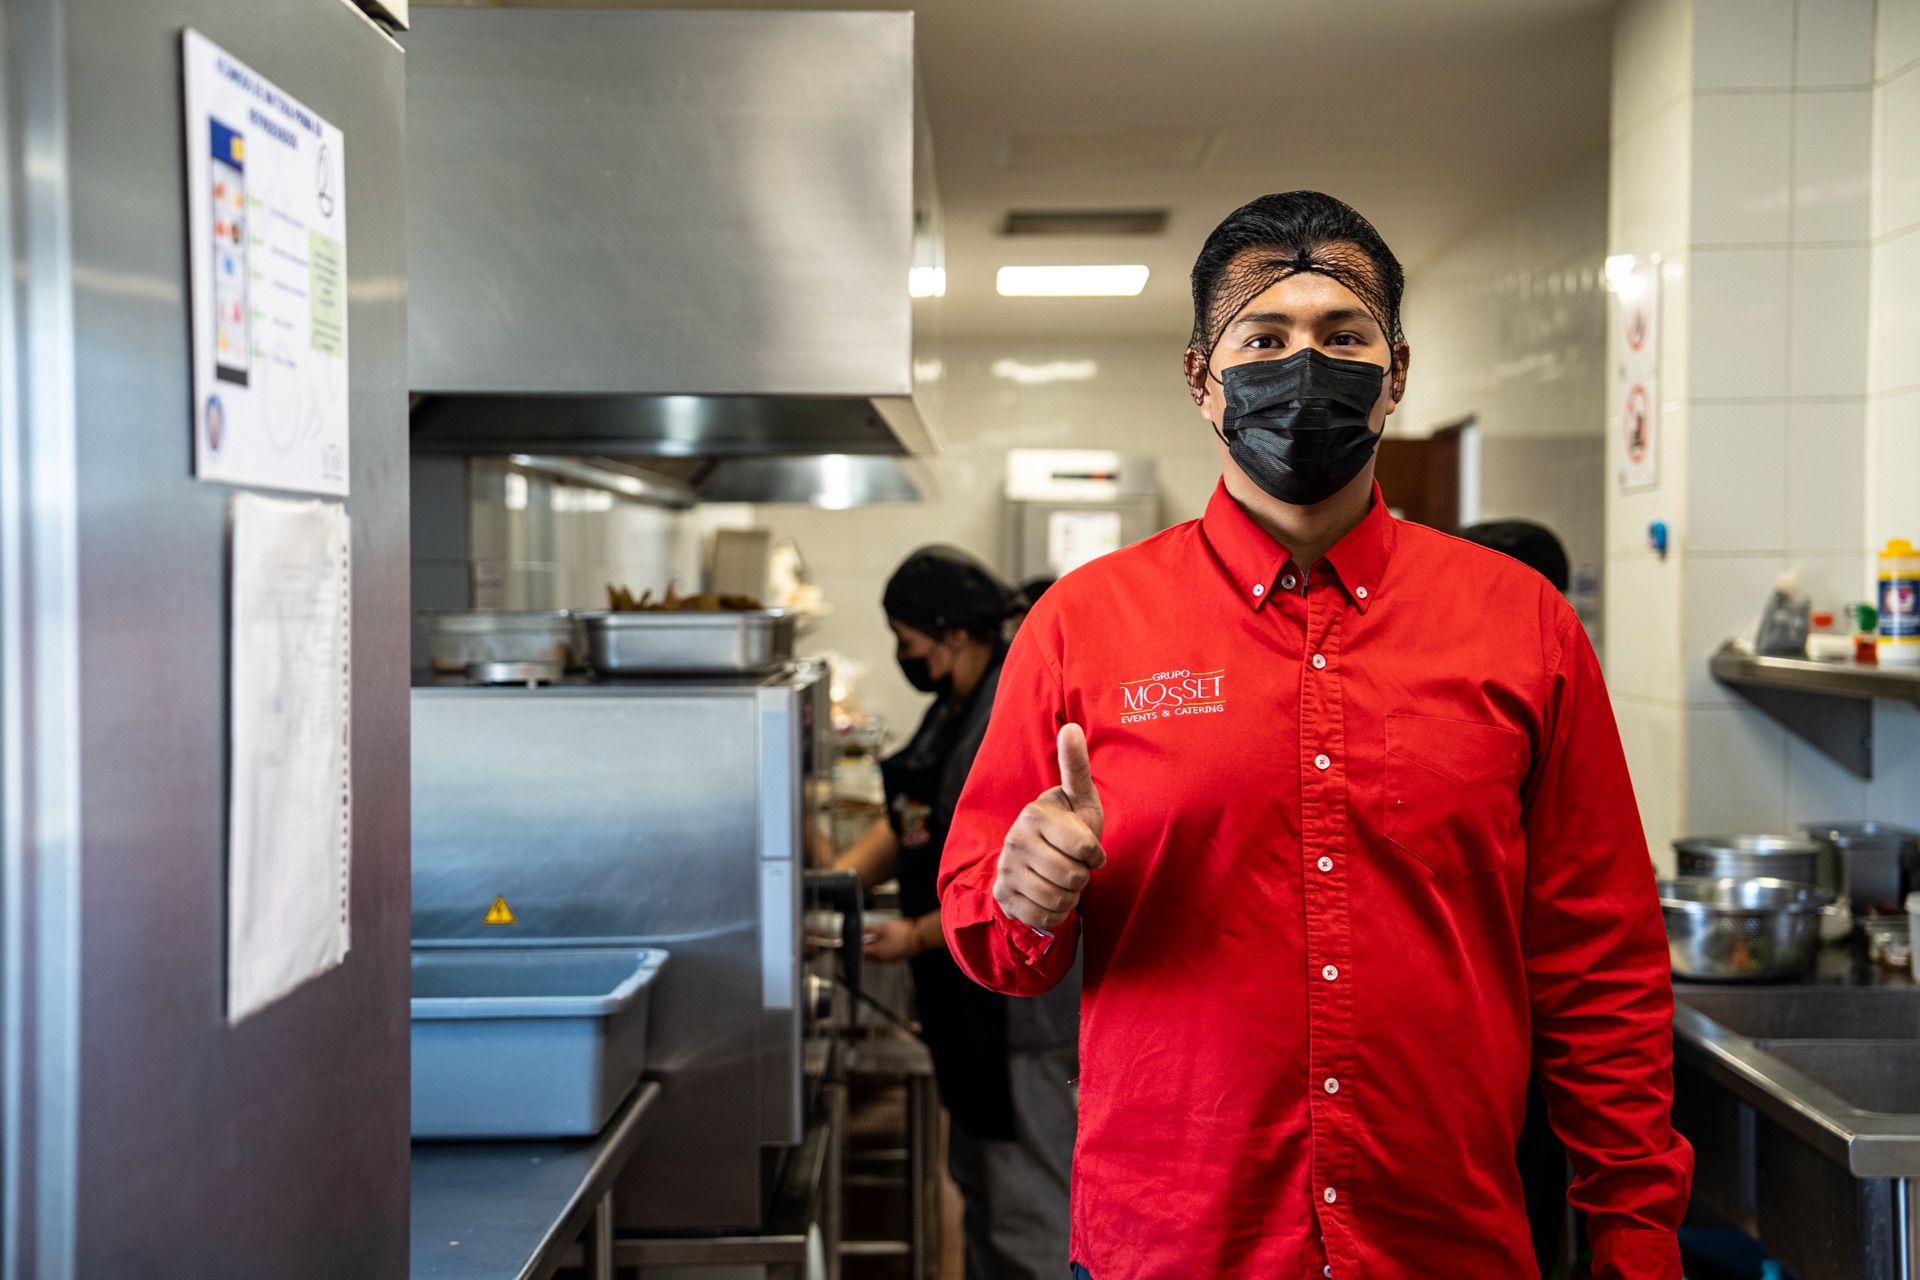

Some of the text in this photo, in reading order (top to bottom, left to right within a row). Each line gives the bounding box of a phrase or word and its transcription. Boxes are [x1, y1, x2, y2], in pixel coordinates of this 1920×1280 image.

[1152, 669, 1190, 681] GRUPO
[1119, 675, 1225, 711] MOSSET
[1121, 704, 1224, 724] EVENTS & CATERING
